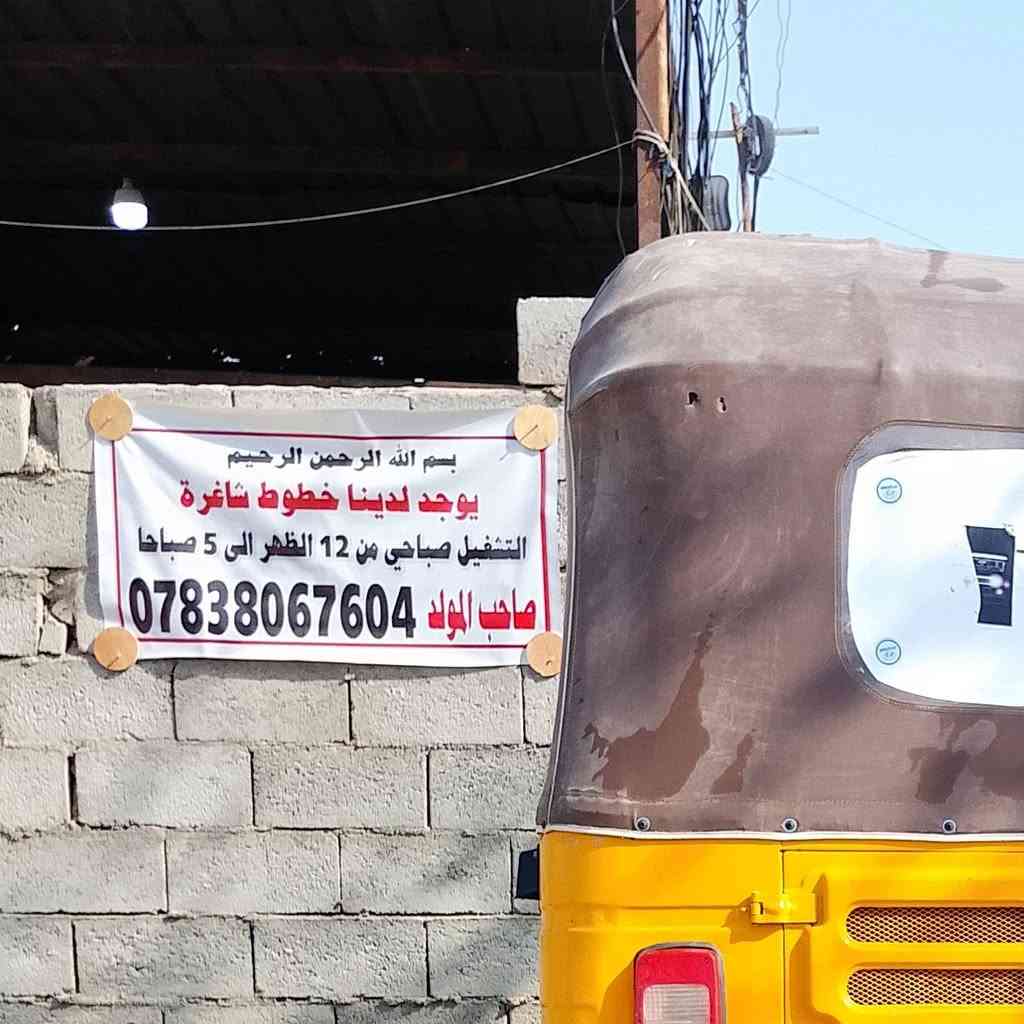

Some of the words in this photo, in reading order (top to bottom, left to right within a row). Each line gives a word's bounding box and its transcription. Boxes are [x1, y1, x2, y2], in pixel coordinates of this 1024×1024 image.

[227, 446, 302, 469] الرحيم
[310, 449, 381, 471] الرحمن
[389, 445, 416, 467] الله
[423, 453, 457, 474] بسم
[179, 479, 250, 516] شاغرة
[257, 481, 340, 517] خطوط
[347, 483, 410, 520] لدينا
[418, 492, 479, 522] يوجد
[138, 526, 197, 562] صباحا
[203, 532, 217, 556] 5
[224, 530, 253, 563] الى
[260, 530, 313, 564] الظهر
[320, 534, 349, 558] 12
[356, 538, 378, 565] من
[384, 533, 451, 572] صباحي
[128, 577, 417, 639] 07838067604
[427, 588, 473, 641] المولد
[478, 587, 537, 643] صاحب
